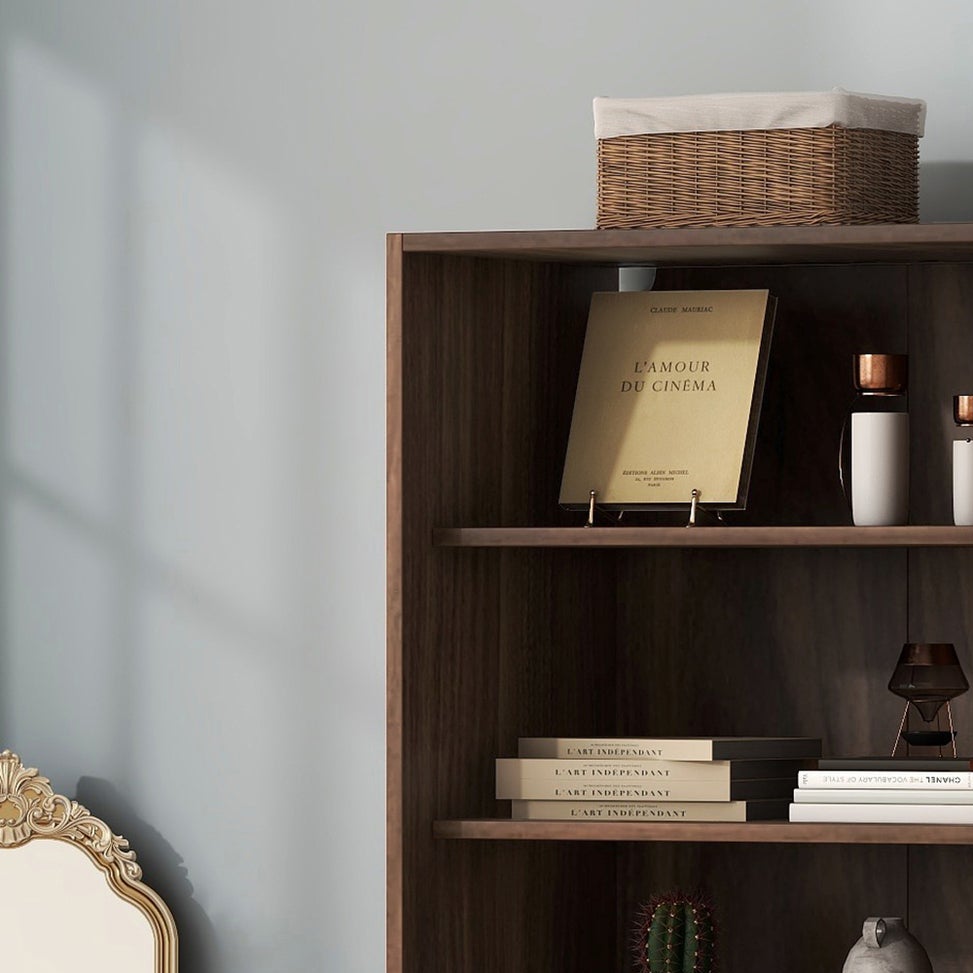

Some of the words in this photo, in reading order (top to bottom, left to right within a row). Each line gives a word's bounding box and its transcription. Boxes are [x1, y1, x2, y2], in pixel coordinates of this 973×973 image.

[650, 306, 677, 314] CLAUDE
[634, 360, 710, 374] L'AMOUR
[621, 380, 645, 393] DU
[652, 379, 717, 392] CINÉMA
[567, 748, 594, 756] L'ART
[596, 747, 663, 756] INDÉPENDANT
[592, 767, 671, 777] INDÉPENDANT
[925, 776, 961, 784] CHANEL
[592, 787, 671, 797] INDÉPENDANT
[571, 809, 604, 817] L'ART
[608, 807, 687, 817] INDÉPENDANT
